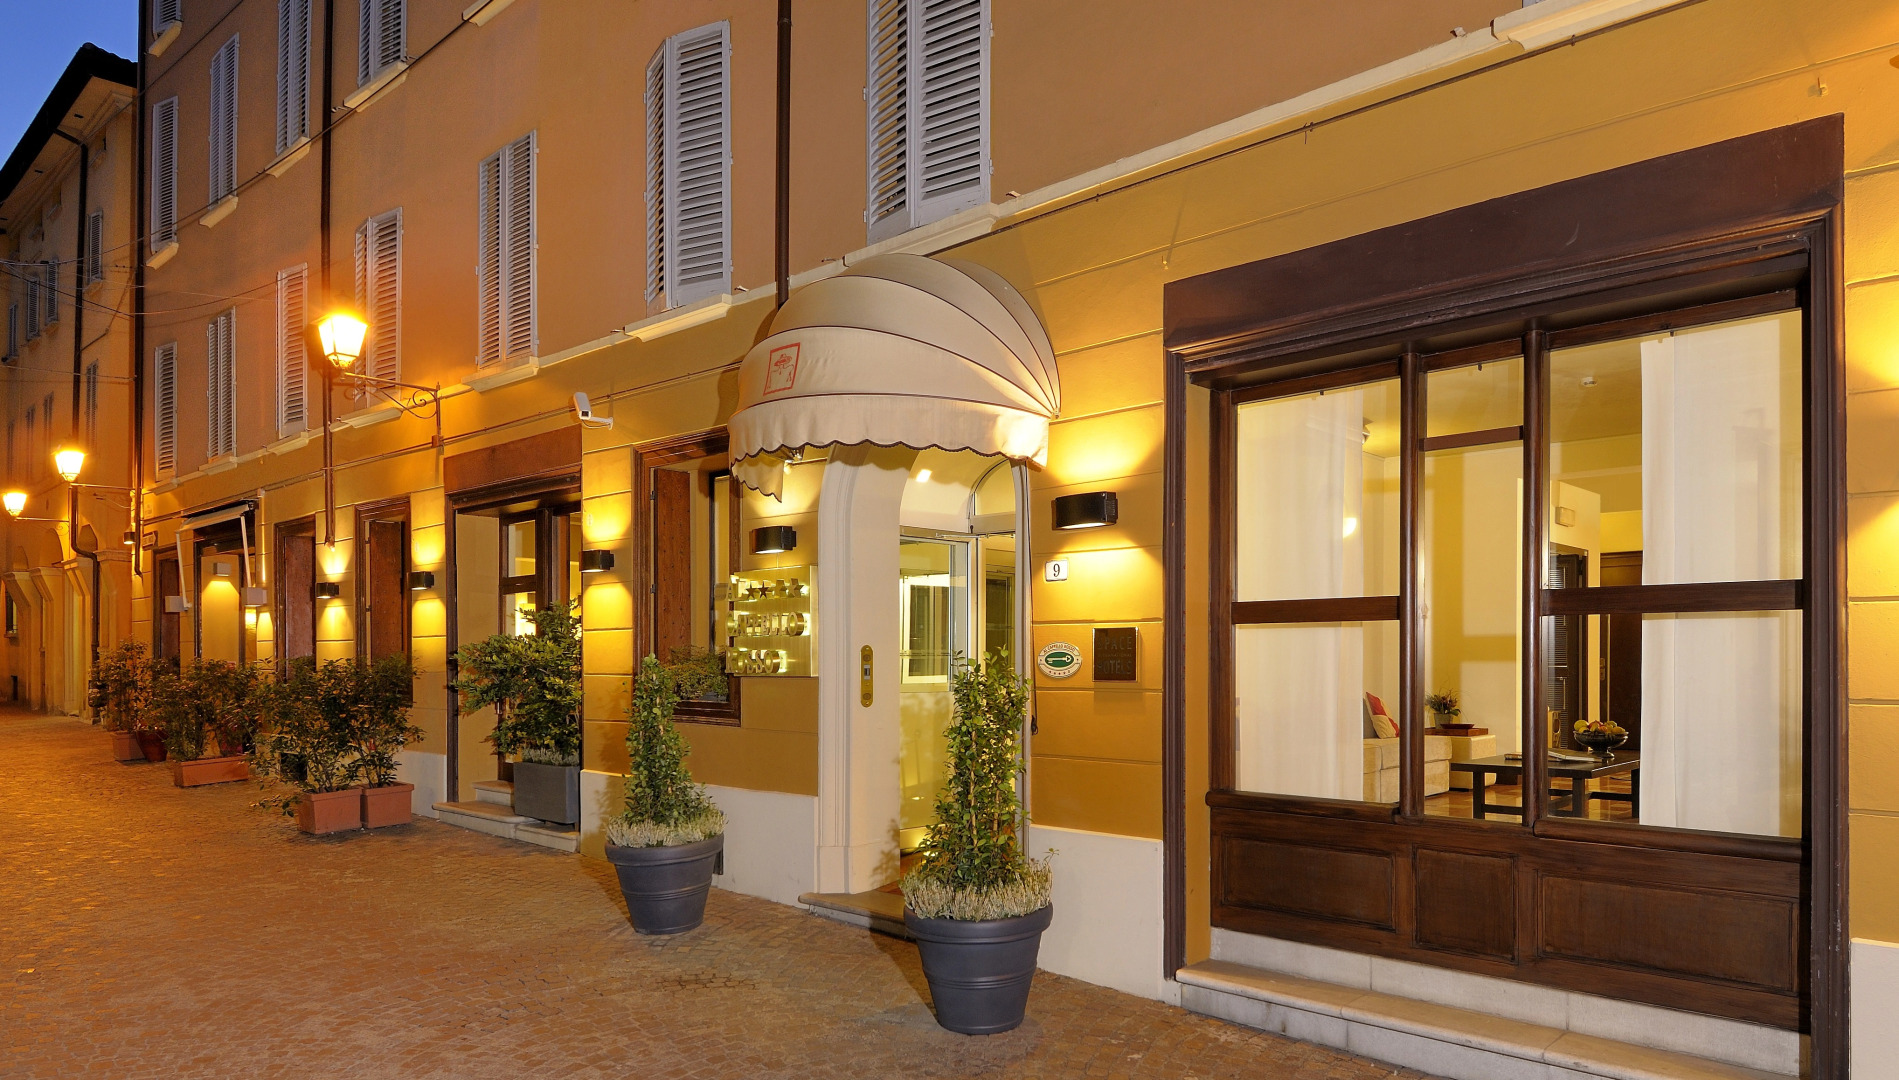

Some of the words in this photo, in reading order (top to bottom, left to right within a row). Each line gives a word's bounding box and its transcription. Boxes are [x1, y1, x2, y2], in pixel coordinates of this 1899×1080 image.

[1053, 563, 1061, 578] 9
[727, 576, 746, 602] AL
[726, 611, 803, 637] CAPPELLO
[1097, 636, 1132, 651] SPACE
[725, 646, 779, 674] ROSSO
[1097, 659, 1132, 675] HOTELS
